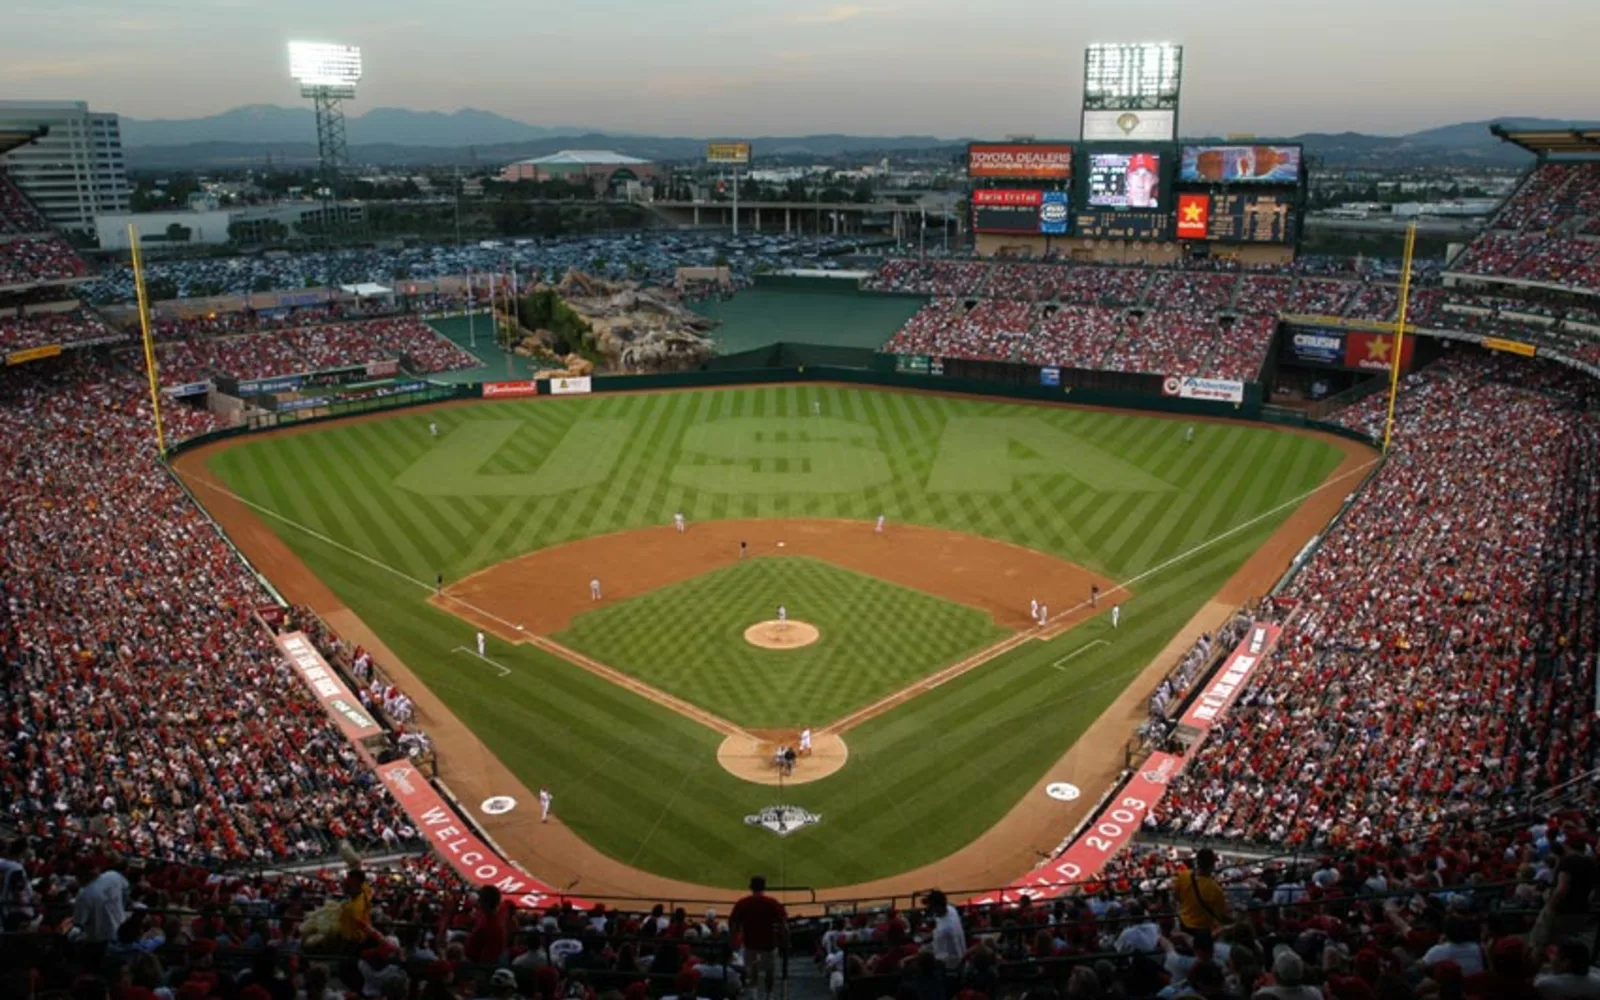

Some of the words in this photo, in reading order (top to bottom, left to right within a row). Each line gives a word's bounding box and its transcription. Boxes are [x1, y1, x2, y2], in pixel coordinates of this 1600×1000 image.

[970, 152, 1013, 162] TOYOTA
[1016, 152, 1072, 163] DEALERS
[1085, 797, 1146, 852] 2003
[420, 805, 549, 907] WELCOME
